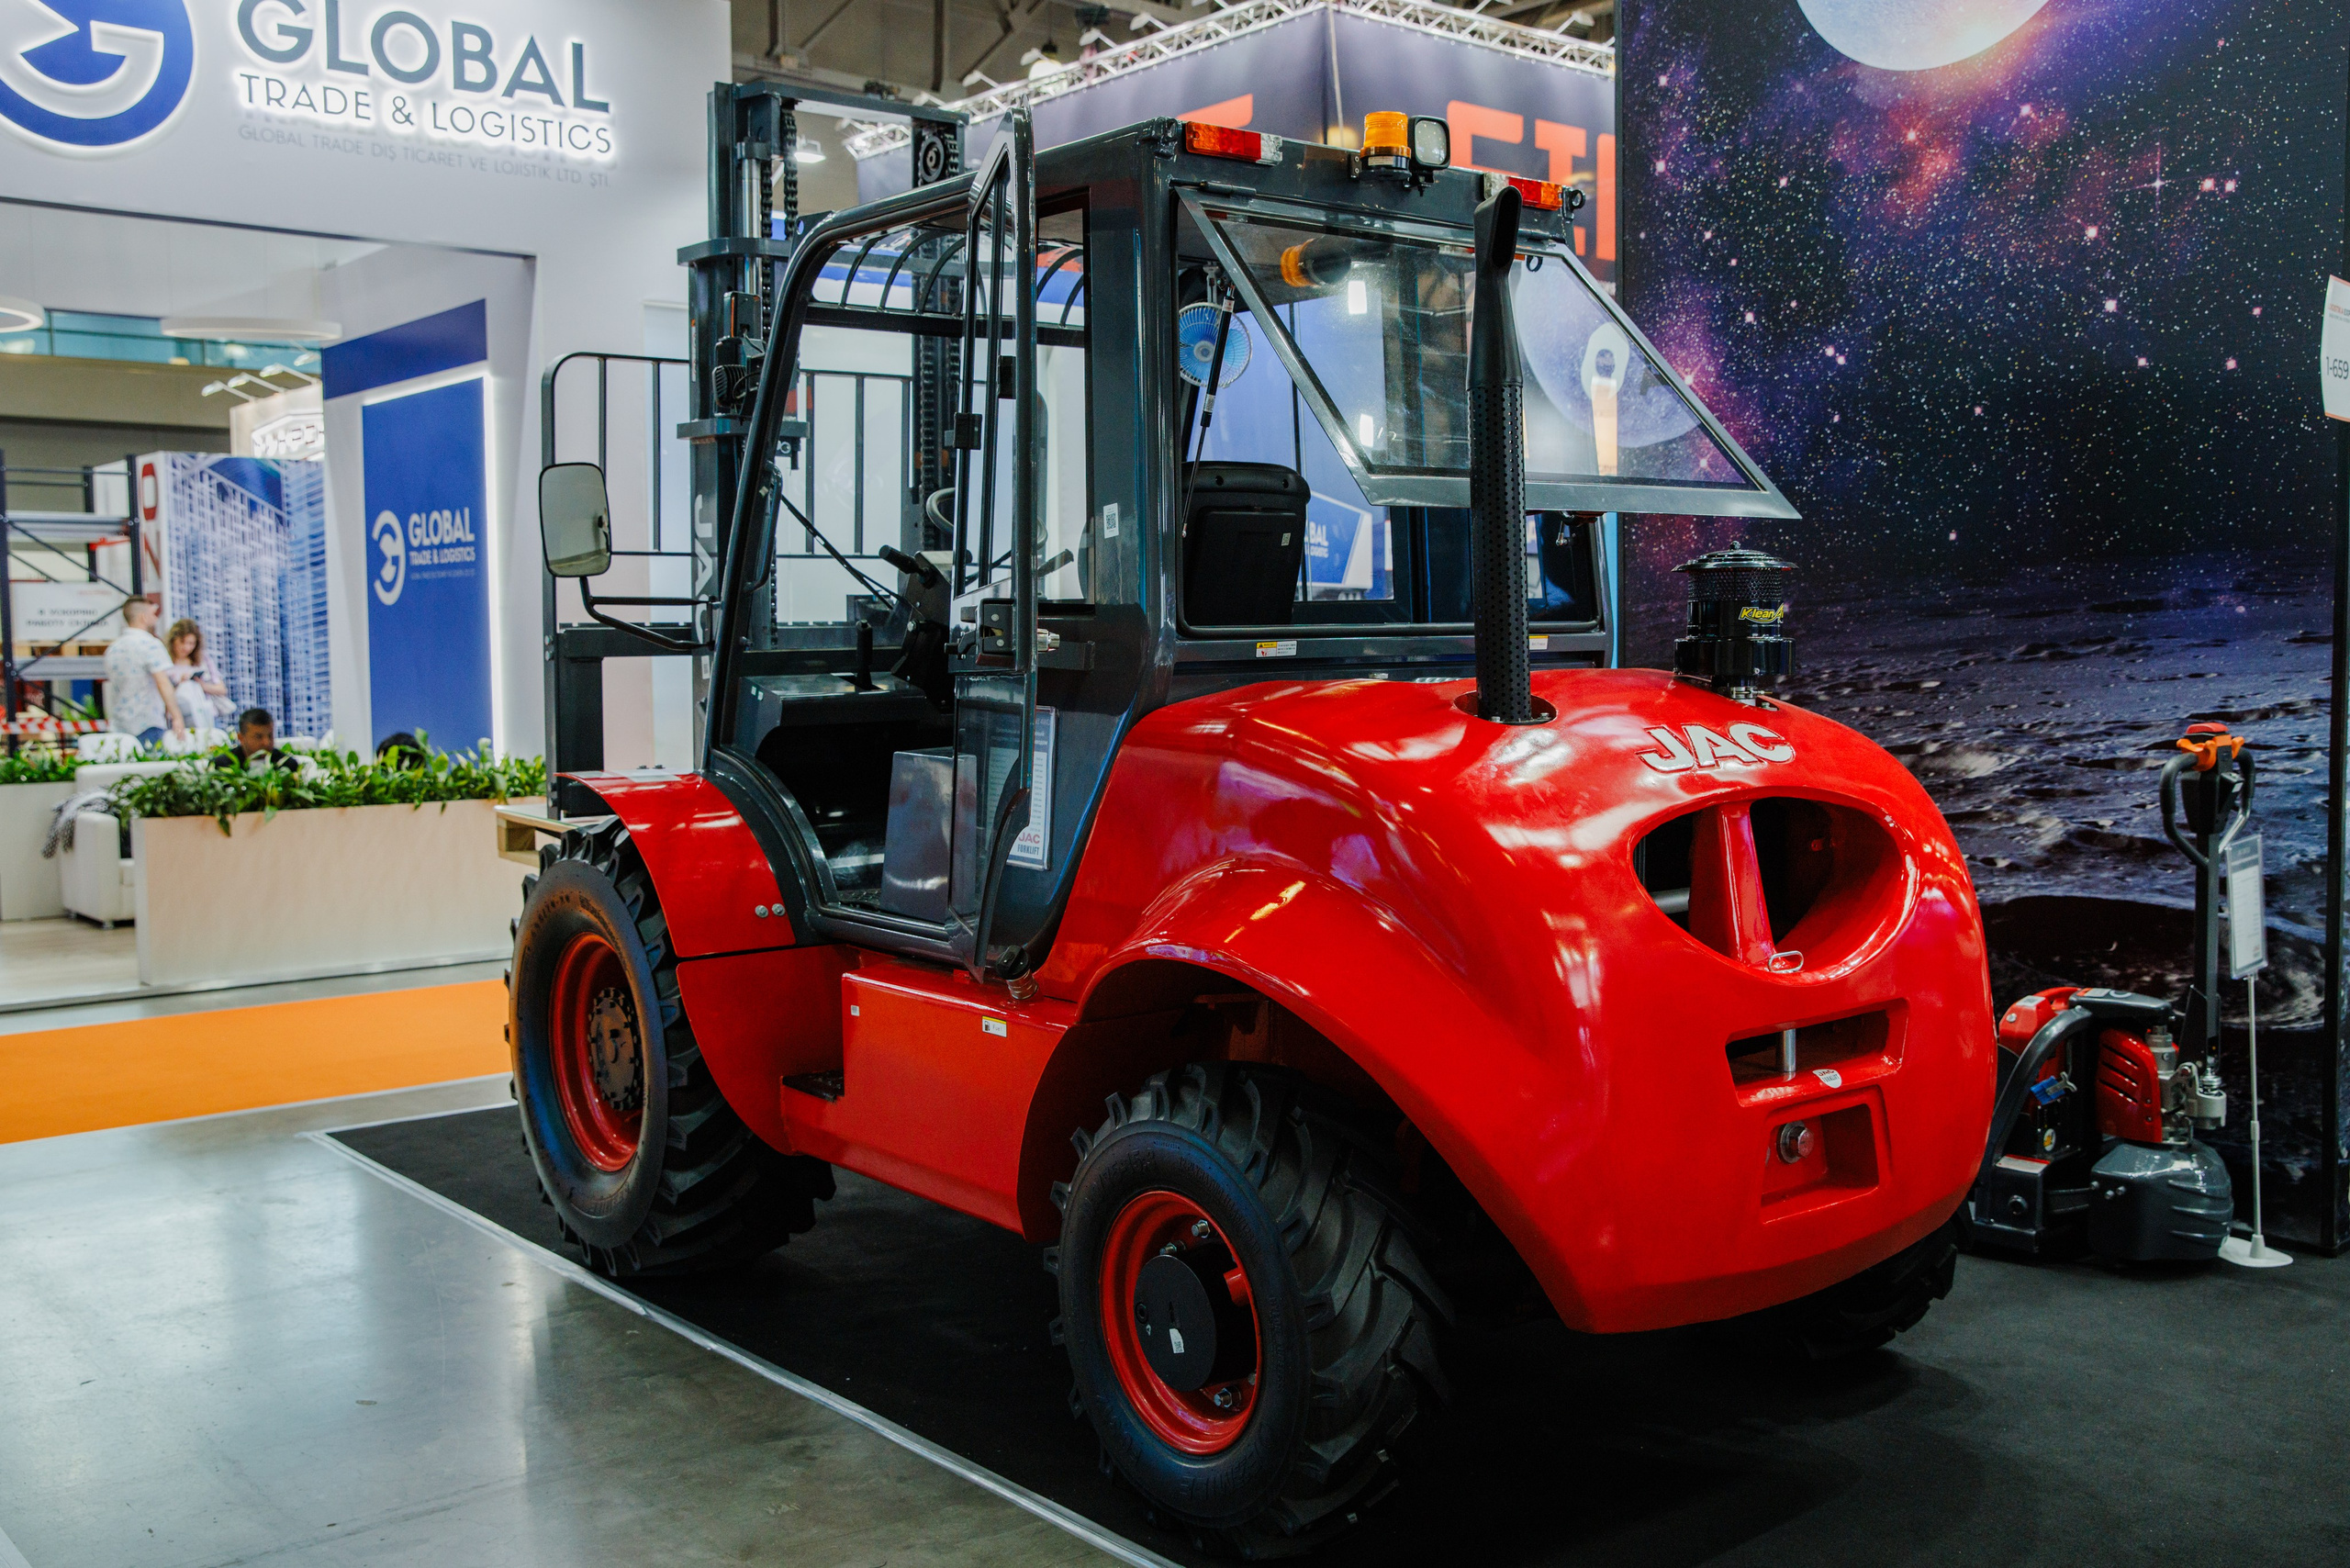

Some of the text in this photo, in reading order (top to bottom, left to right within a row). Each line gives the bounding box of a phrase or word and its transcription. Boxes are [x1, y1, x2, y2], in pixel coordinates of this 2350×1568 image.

[237, 0, 610, 114] GLOBAL
[240, 73, 612, 154] TRADE & LOGISTICS
[238, 124, 307, 148] GLOBAL
[312, 134, 365, 156] TRADE
[469, 156, 488, 173] VE
[408, 507, 475, 548] GLOBAL
[408, 549, 432, 566] TRADE
[440, 546, 476, 564] LOGISTICS
[694, 493, 713, 645] JAC
[1634, 720, 1797, 776] JAC
[1018, 844, 1039, 856] FORKLIFT
[1019, 833, 1040, 844] JAC
